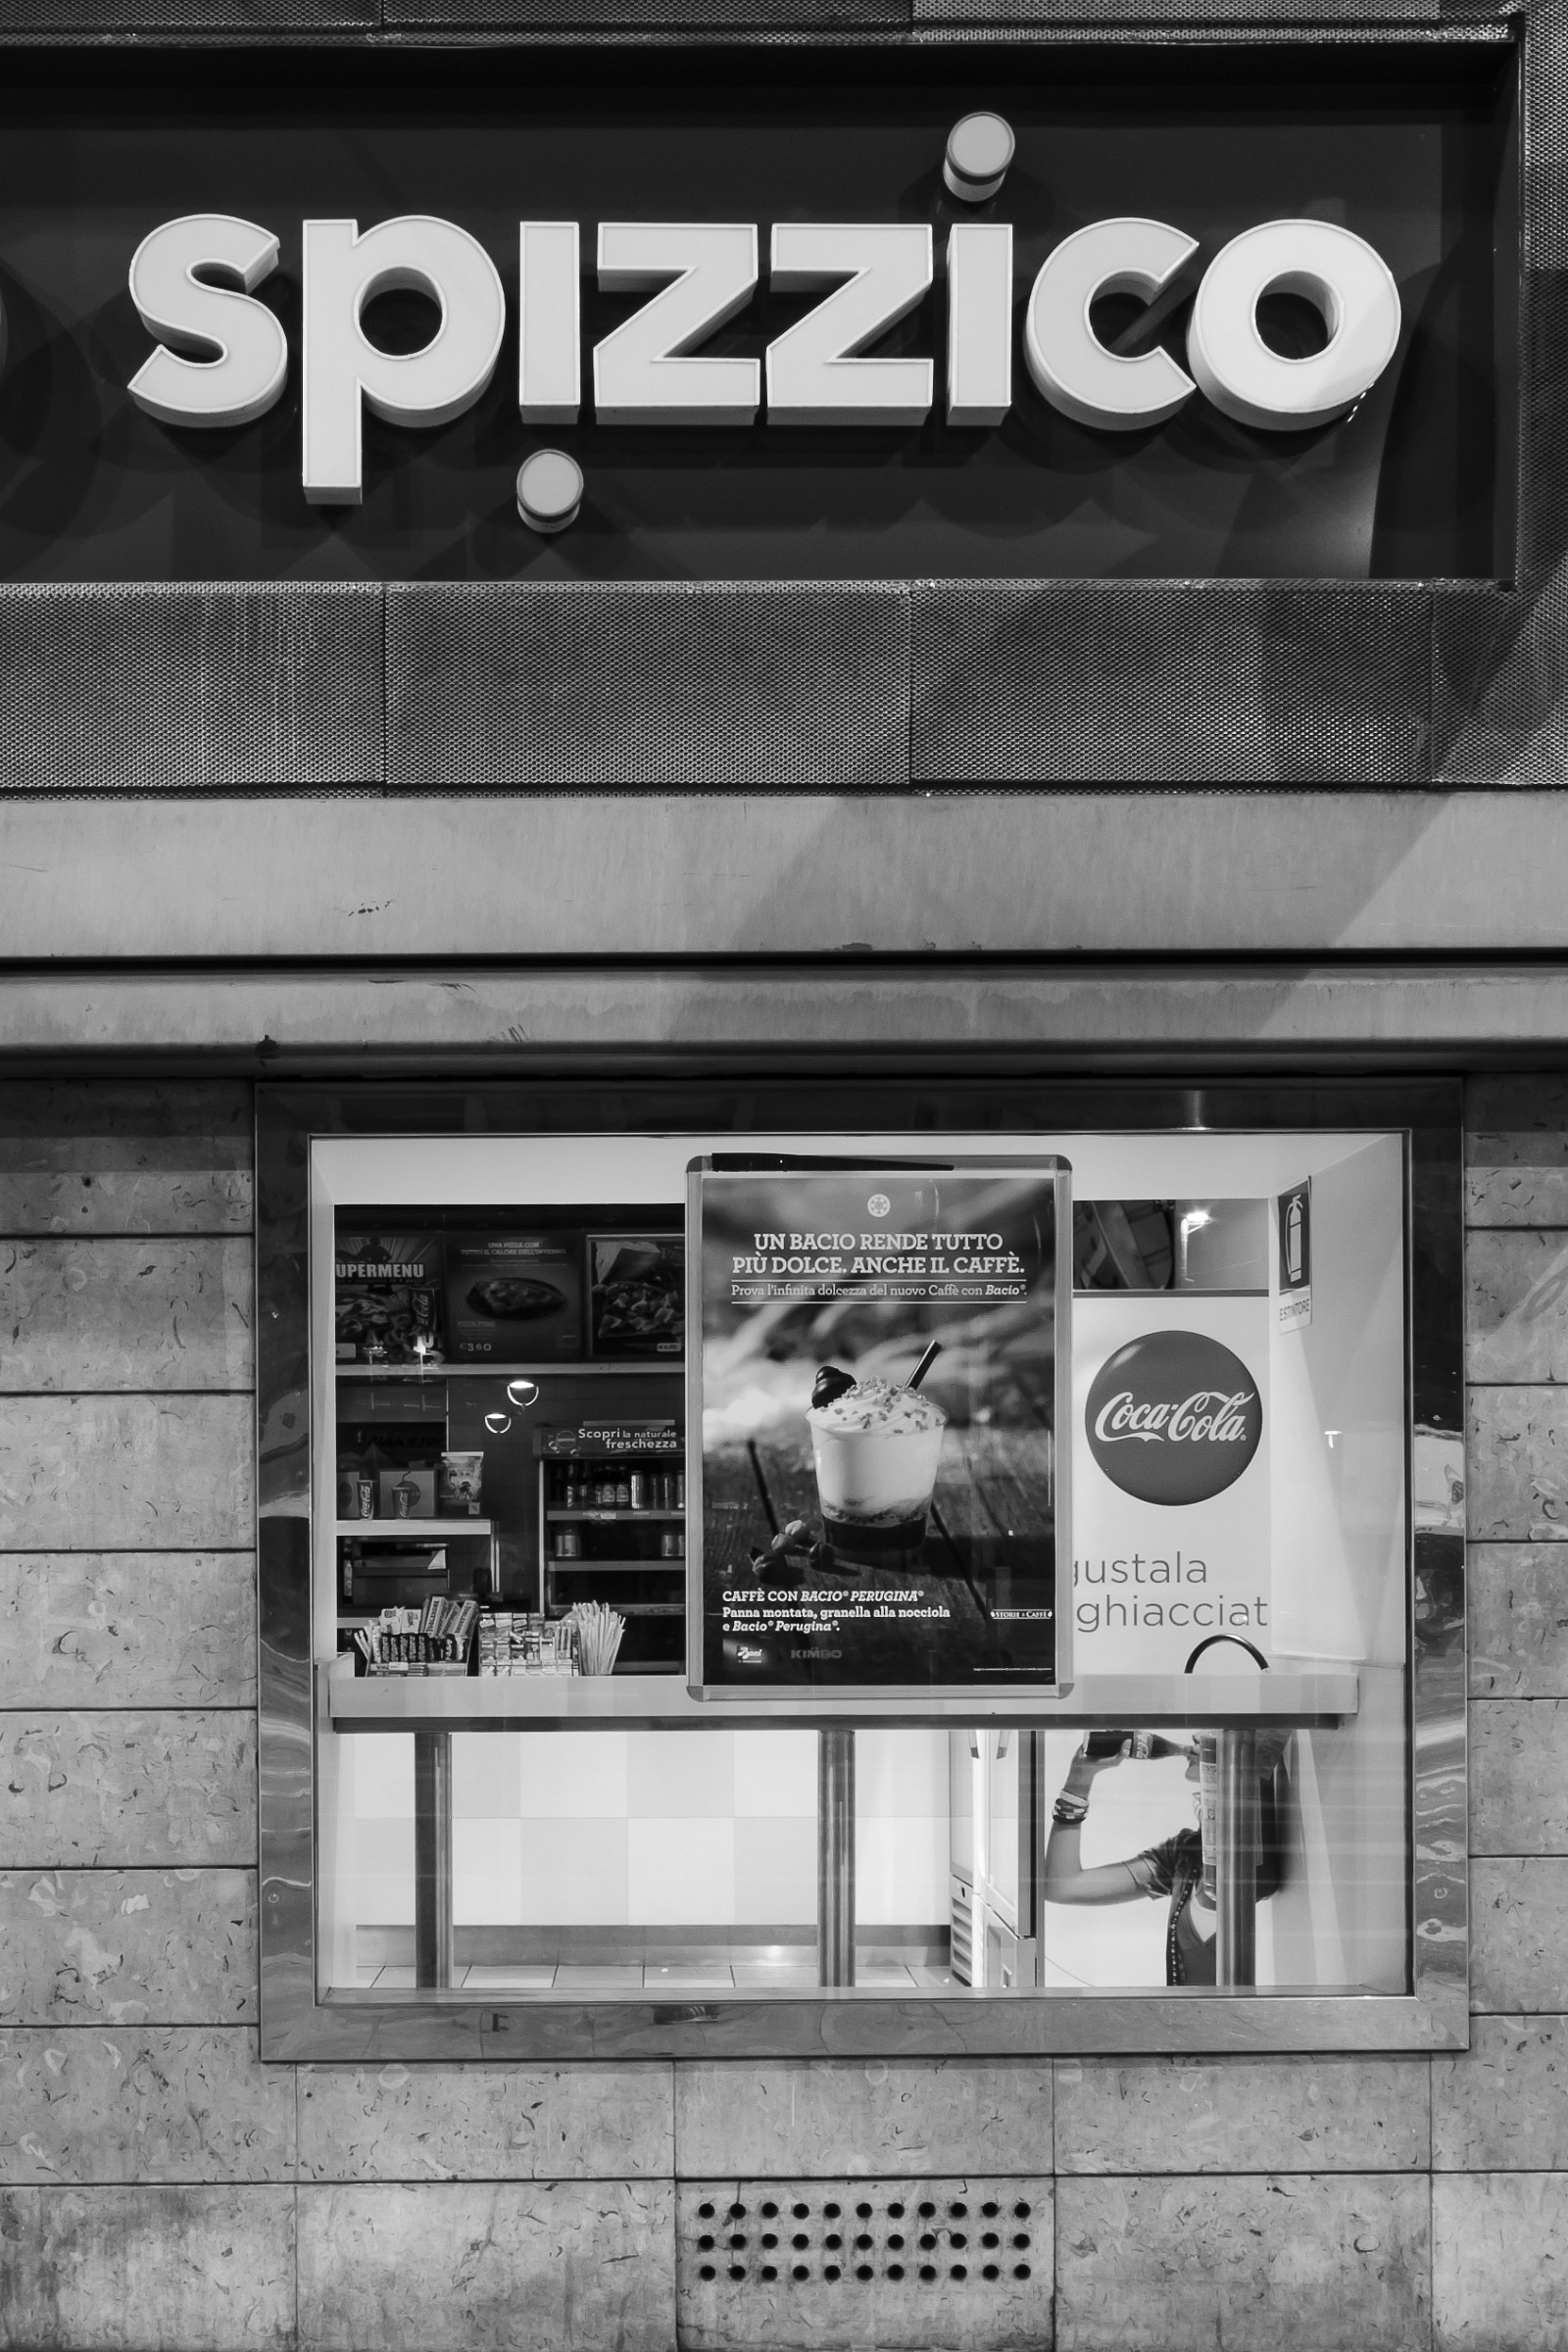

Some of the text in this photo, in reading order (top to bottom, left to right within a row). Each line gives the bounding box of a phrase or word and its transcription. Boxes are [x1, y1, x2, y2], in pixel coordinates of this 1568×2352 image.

[127, 111, 1401, 535] spizzico
[754, 1233, 1004, 1250] UN BACIO RENDE TUTTO
[732, 1250, 1025, 1274] PIÙ DOLCE. ANCHE IL CAFFÈ.
[731, 1284, 764, 1296] Prova
[767, 1284, 815, 1296] l'infinita
[817, 1284, 866, 1296] dolcezza
[869, 1284, 888, 1296] del
[890, 1287, 926, 1296] nuovo
[928, 1284, 959, 1296] Caffè
[961, 1287, 983, 1296] con
[1280, 1298, 1310, 1321] ESTINTORE
[1095, 1392, 1255, 1443] Coca-Cola
[577, 1428, 677, 1441] Scopri la naturale
[606, 1439, 677, 1449] freschezza
[722, 1588, 765, 1602] CAFFÈ
[767, 1591, 799, 1602] CON
[722, 1605, 951, 1620] Panna montata, granella alla nocciola
[722, 1623, 730, 1632] e
[790, 1649, 843, 1659] KIMBO
